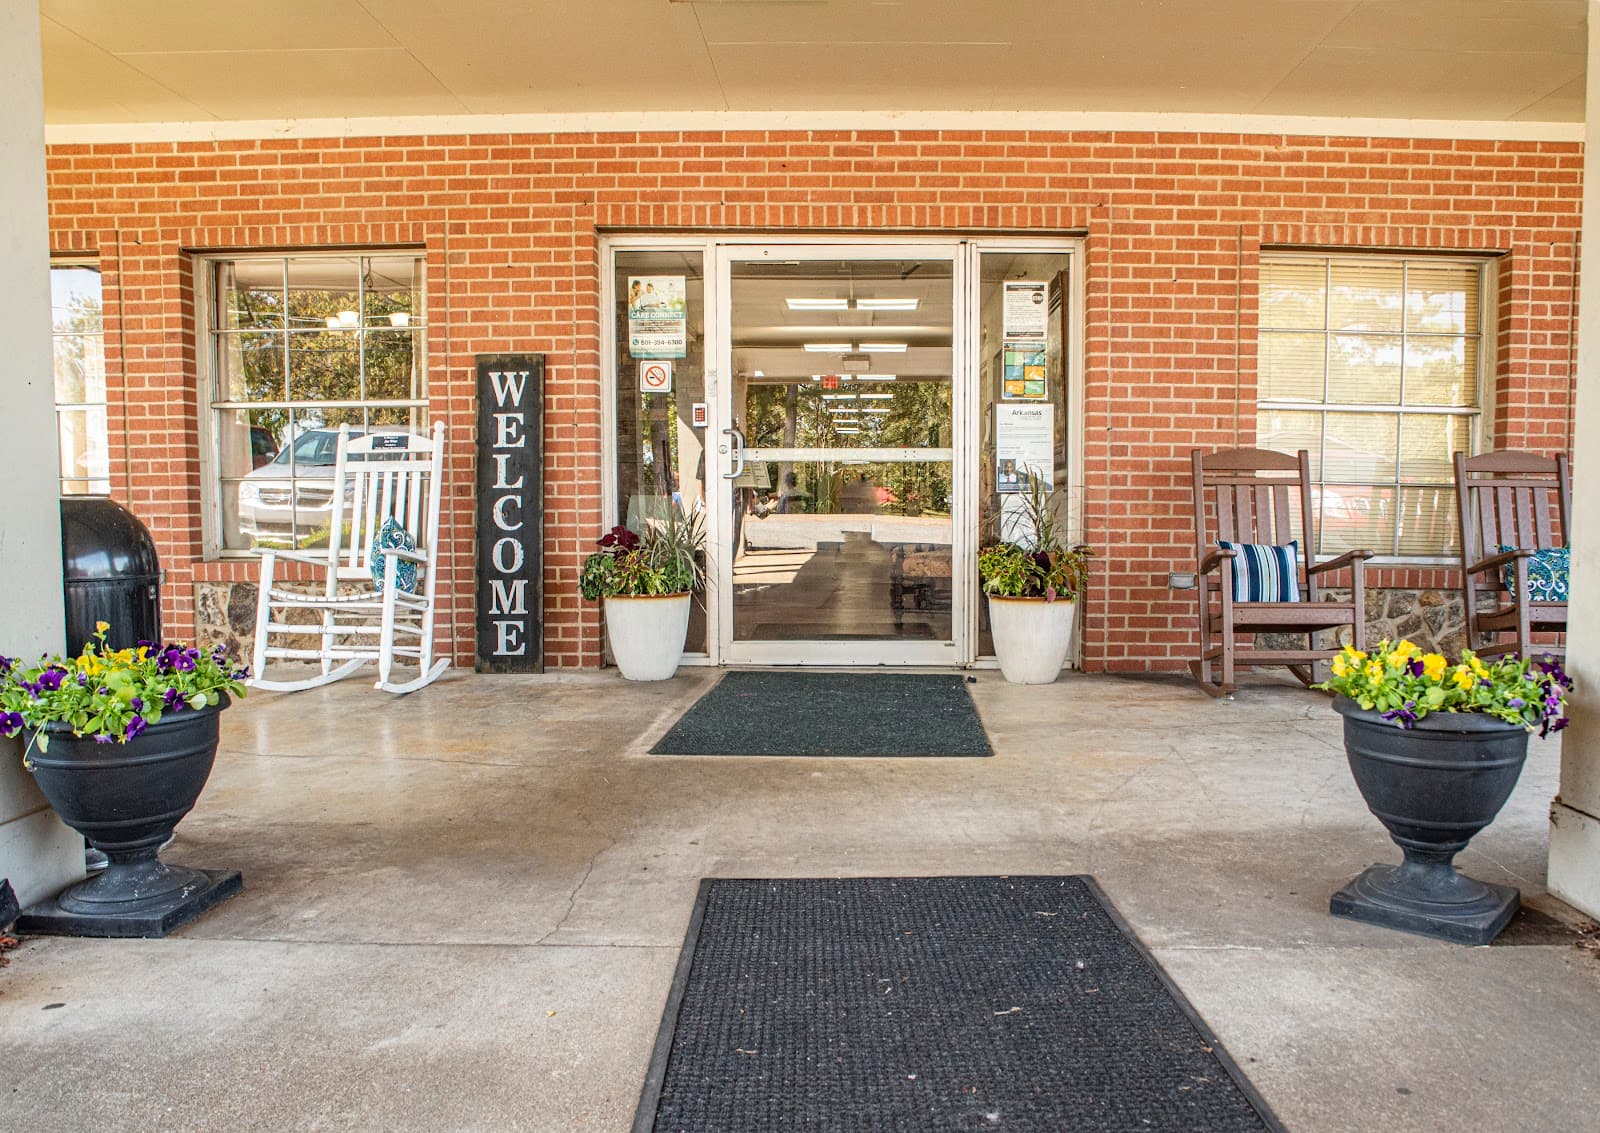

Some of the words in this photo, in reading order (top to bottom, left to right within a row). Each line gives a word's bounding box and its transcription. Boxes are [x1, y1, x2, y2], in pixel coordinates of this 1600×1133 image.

[632, 311, 649, 319] CARE
[650, 311, 682, 319] CONNECT
[488, 371, 529, 656] WELCOME
